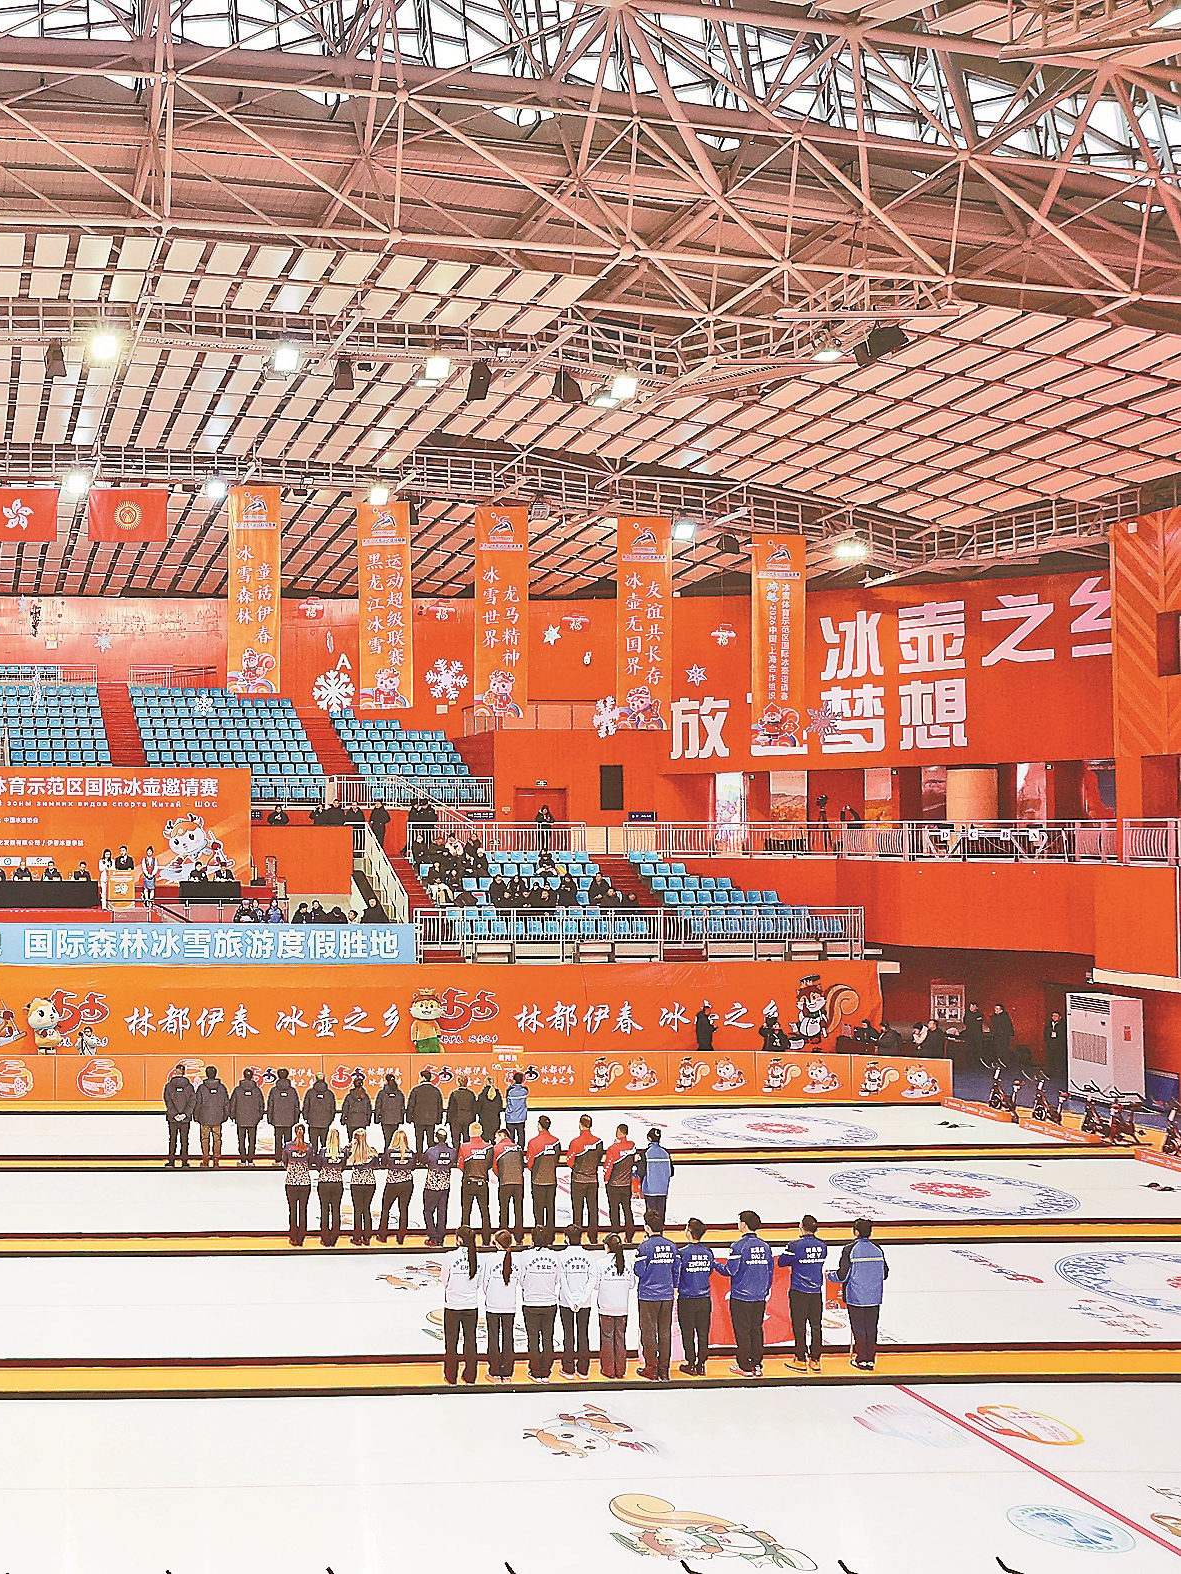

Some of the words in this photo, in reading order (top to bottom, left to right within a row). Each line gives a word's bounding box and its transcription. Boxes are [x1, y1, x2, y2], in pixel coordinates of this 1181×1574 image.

[235, 545, 255, 625] 冰雪森林
[255, 562, 274, 645] 童话伊春
[366, 554, 385, 655] 黑龙江冰雪
[385, 554, 406, 667] 运动超级联赛
[482, 565, 501, 649] 冰雪世界
[501, 584, 521, 667] 龙马精神
[624, 571, 643, 677] 冰壶无国界
[335, 653, 353, 670] A
[644, 581, 664, 685] 友谊共长存
[671, 678, 968, 760] 放梦想
[151, 800, 181, 809] Китай
[24, 928, 399, 960] 国际森林冰雪旅游度假胜地
[123, 1003, 261, 1040] 林都伊春
[275, 1003, 401, 1039] 冰壶之乡
[513, 1000, 645, 1036] 林都伊春
[288, 1067, 315, 1077] 都伊春
